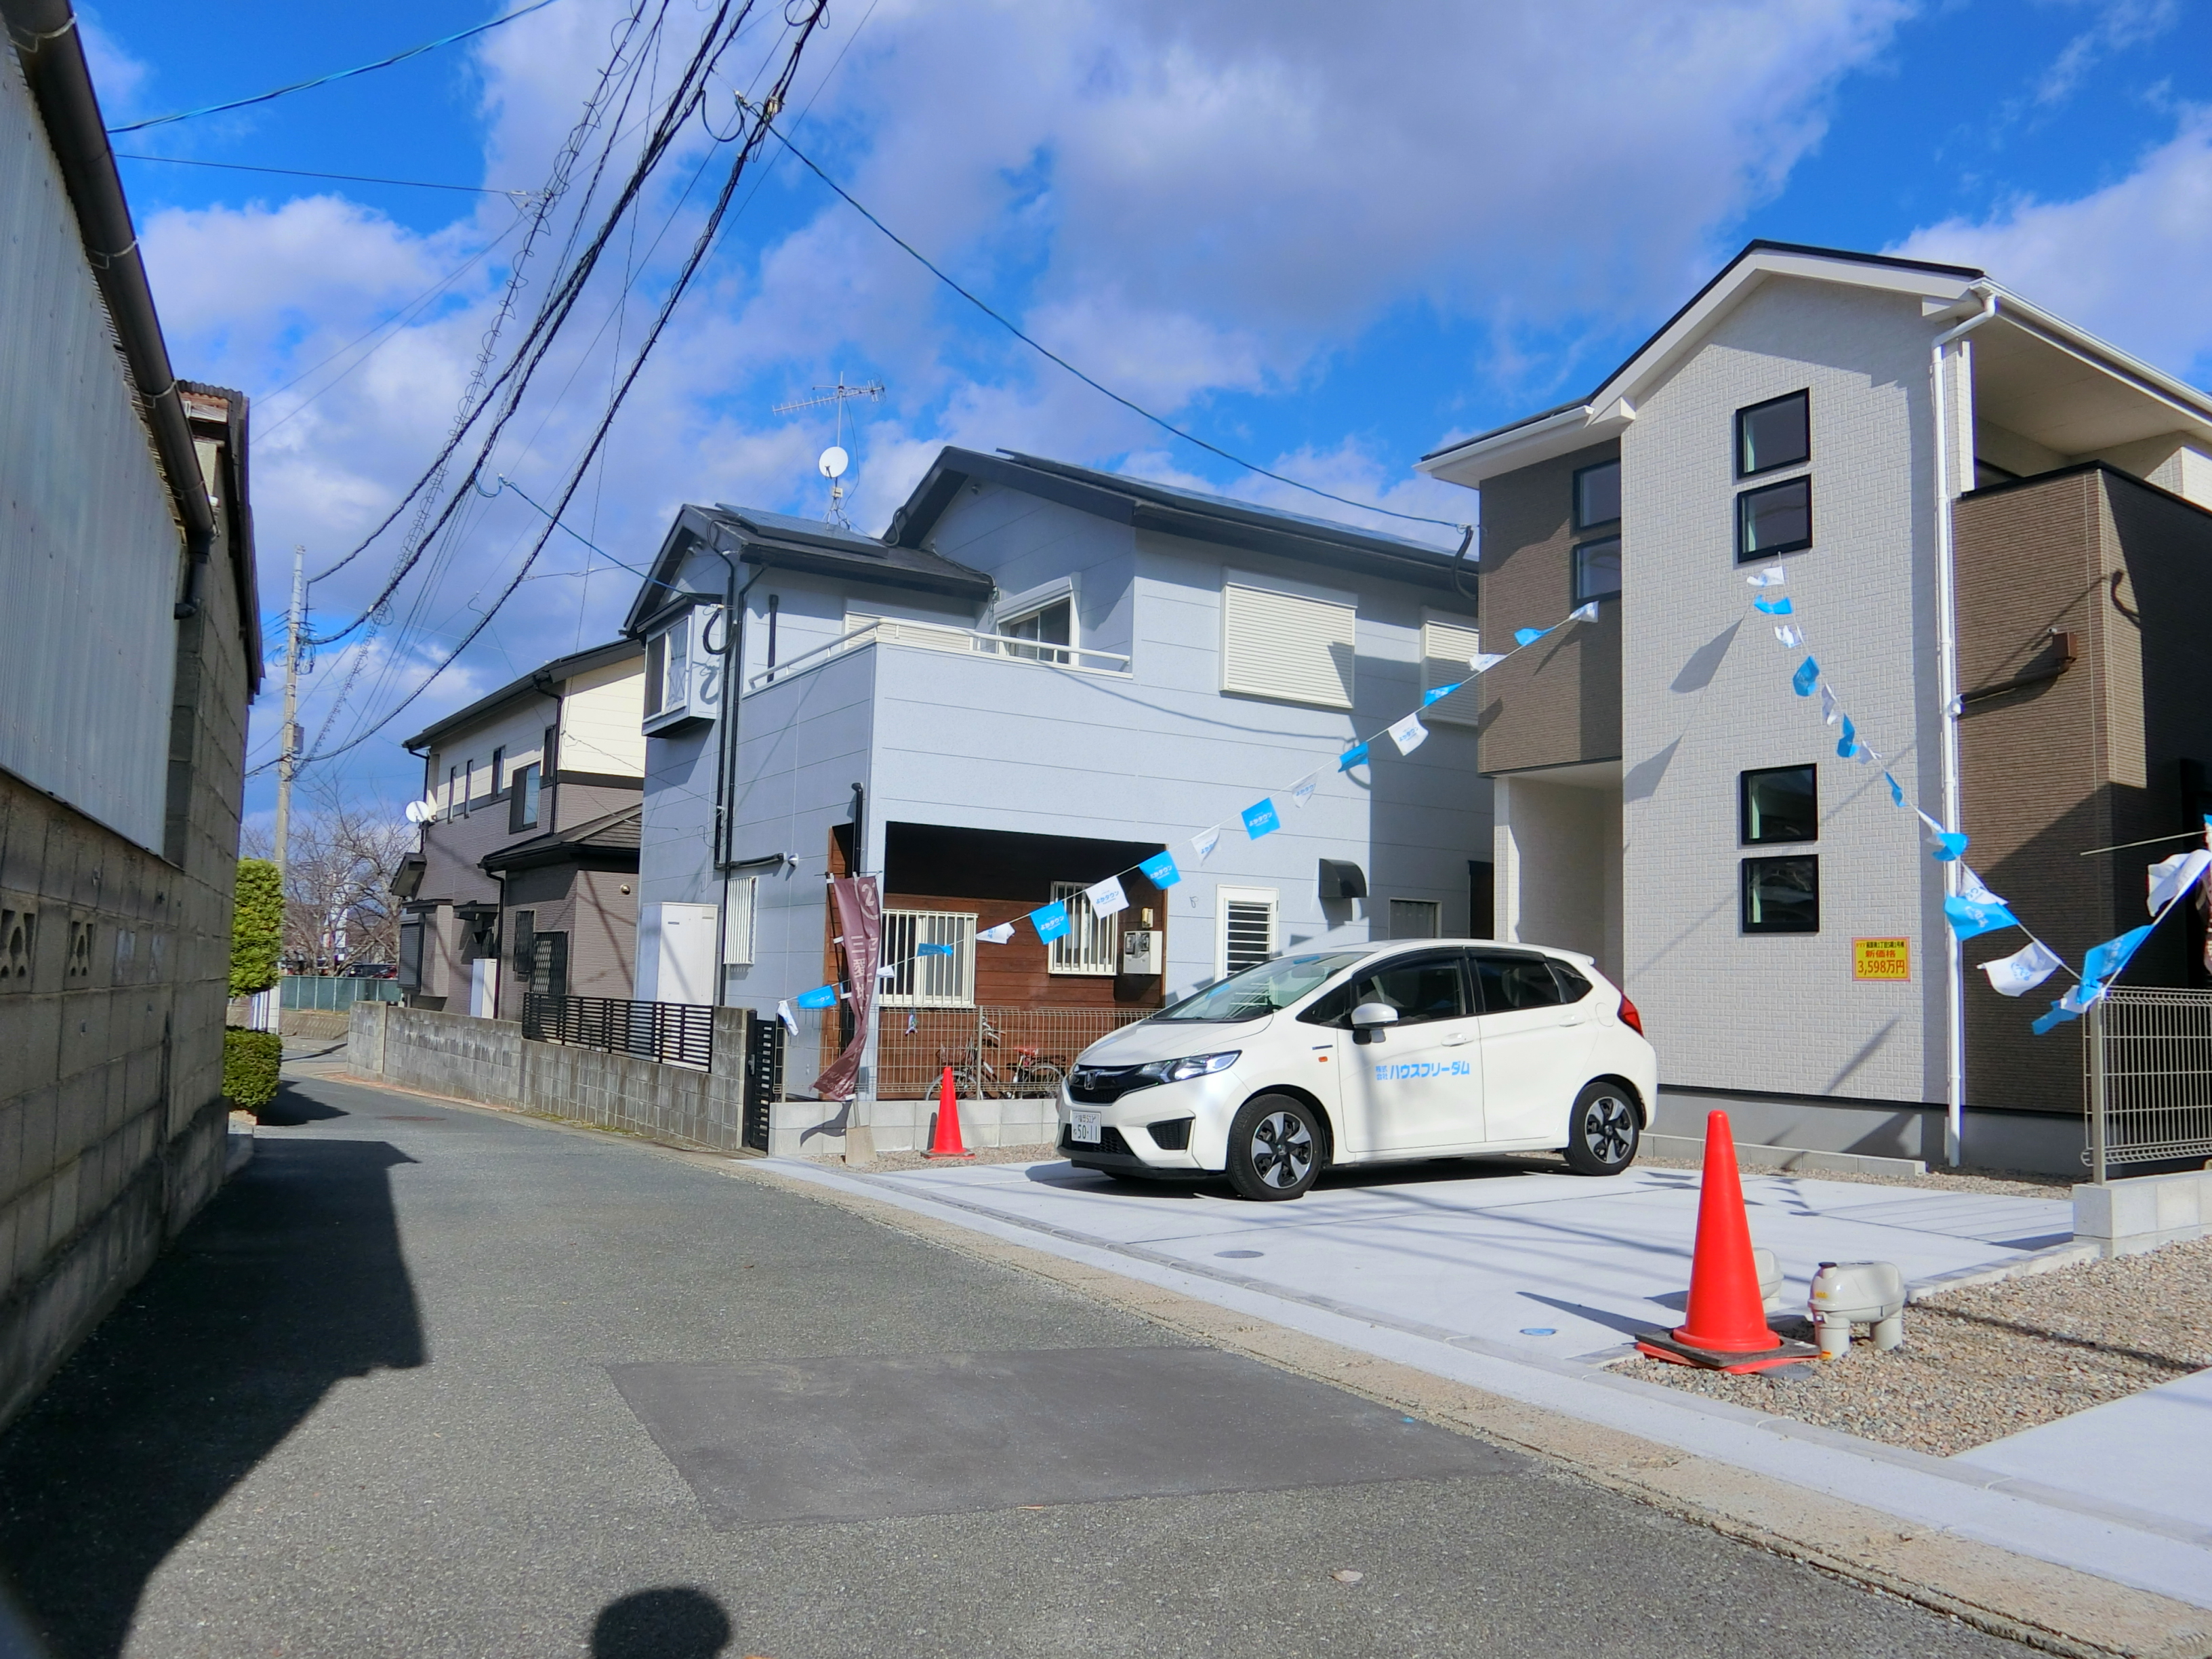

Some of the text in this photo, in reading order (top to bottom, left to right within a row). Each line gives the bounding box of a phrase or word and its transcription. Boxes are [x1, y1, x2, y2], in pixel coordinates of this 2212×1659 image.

[1858, 960, 1905, 975] 3,598万円
[1390, 1061, 1470, 1080] ハウスフリーダム
